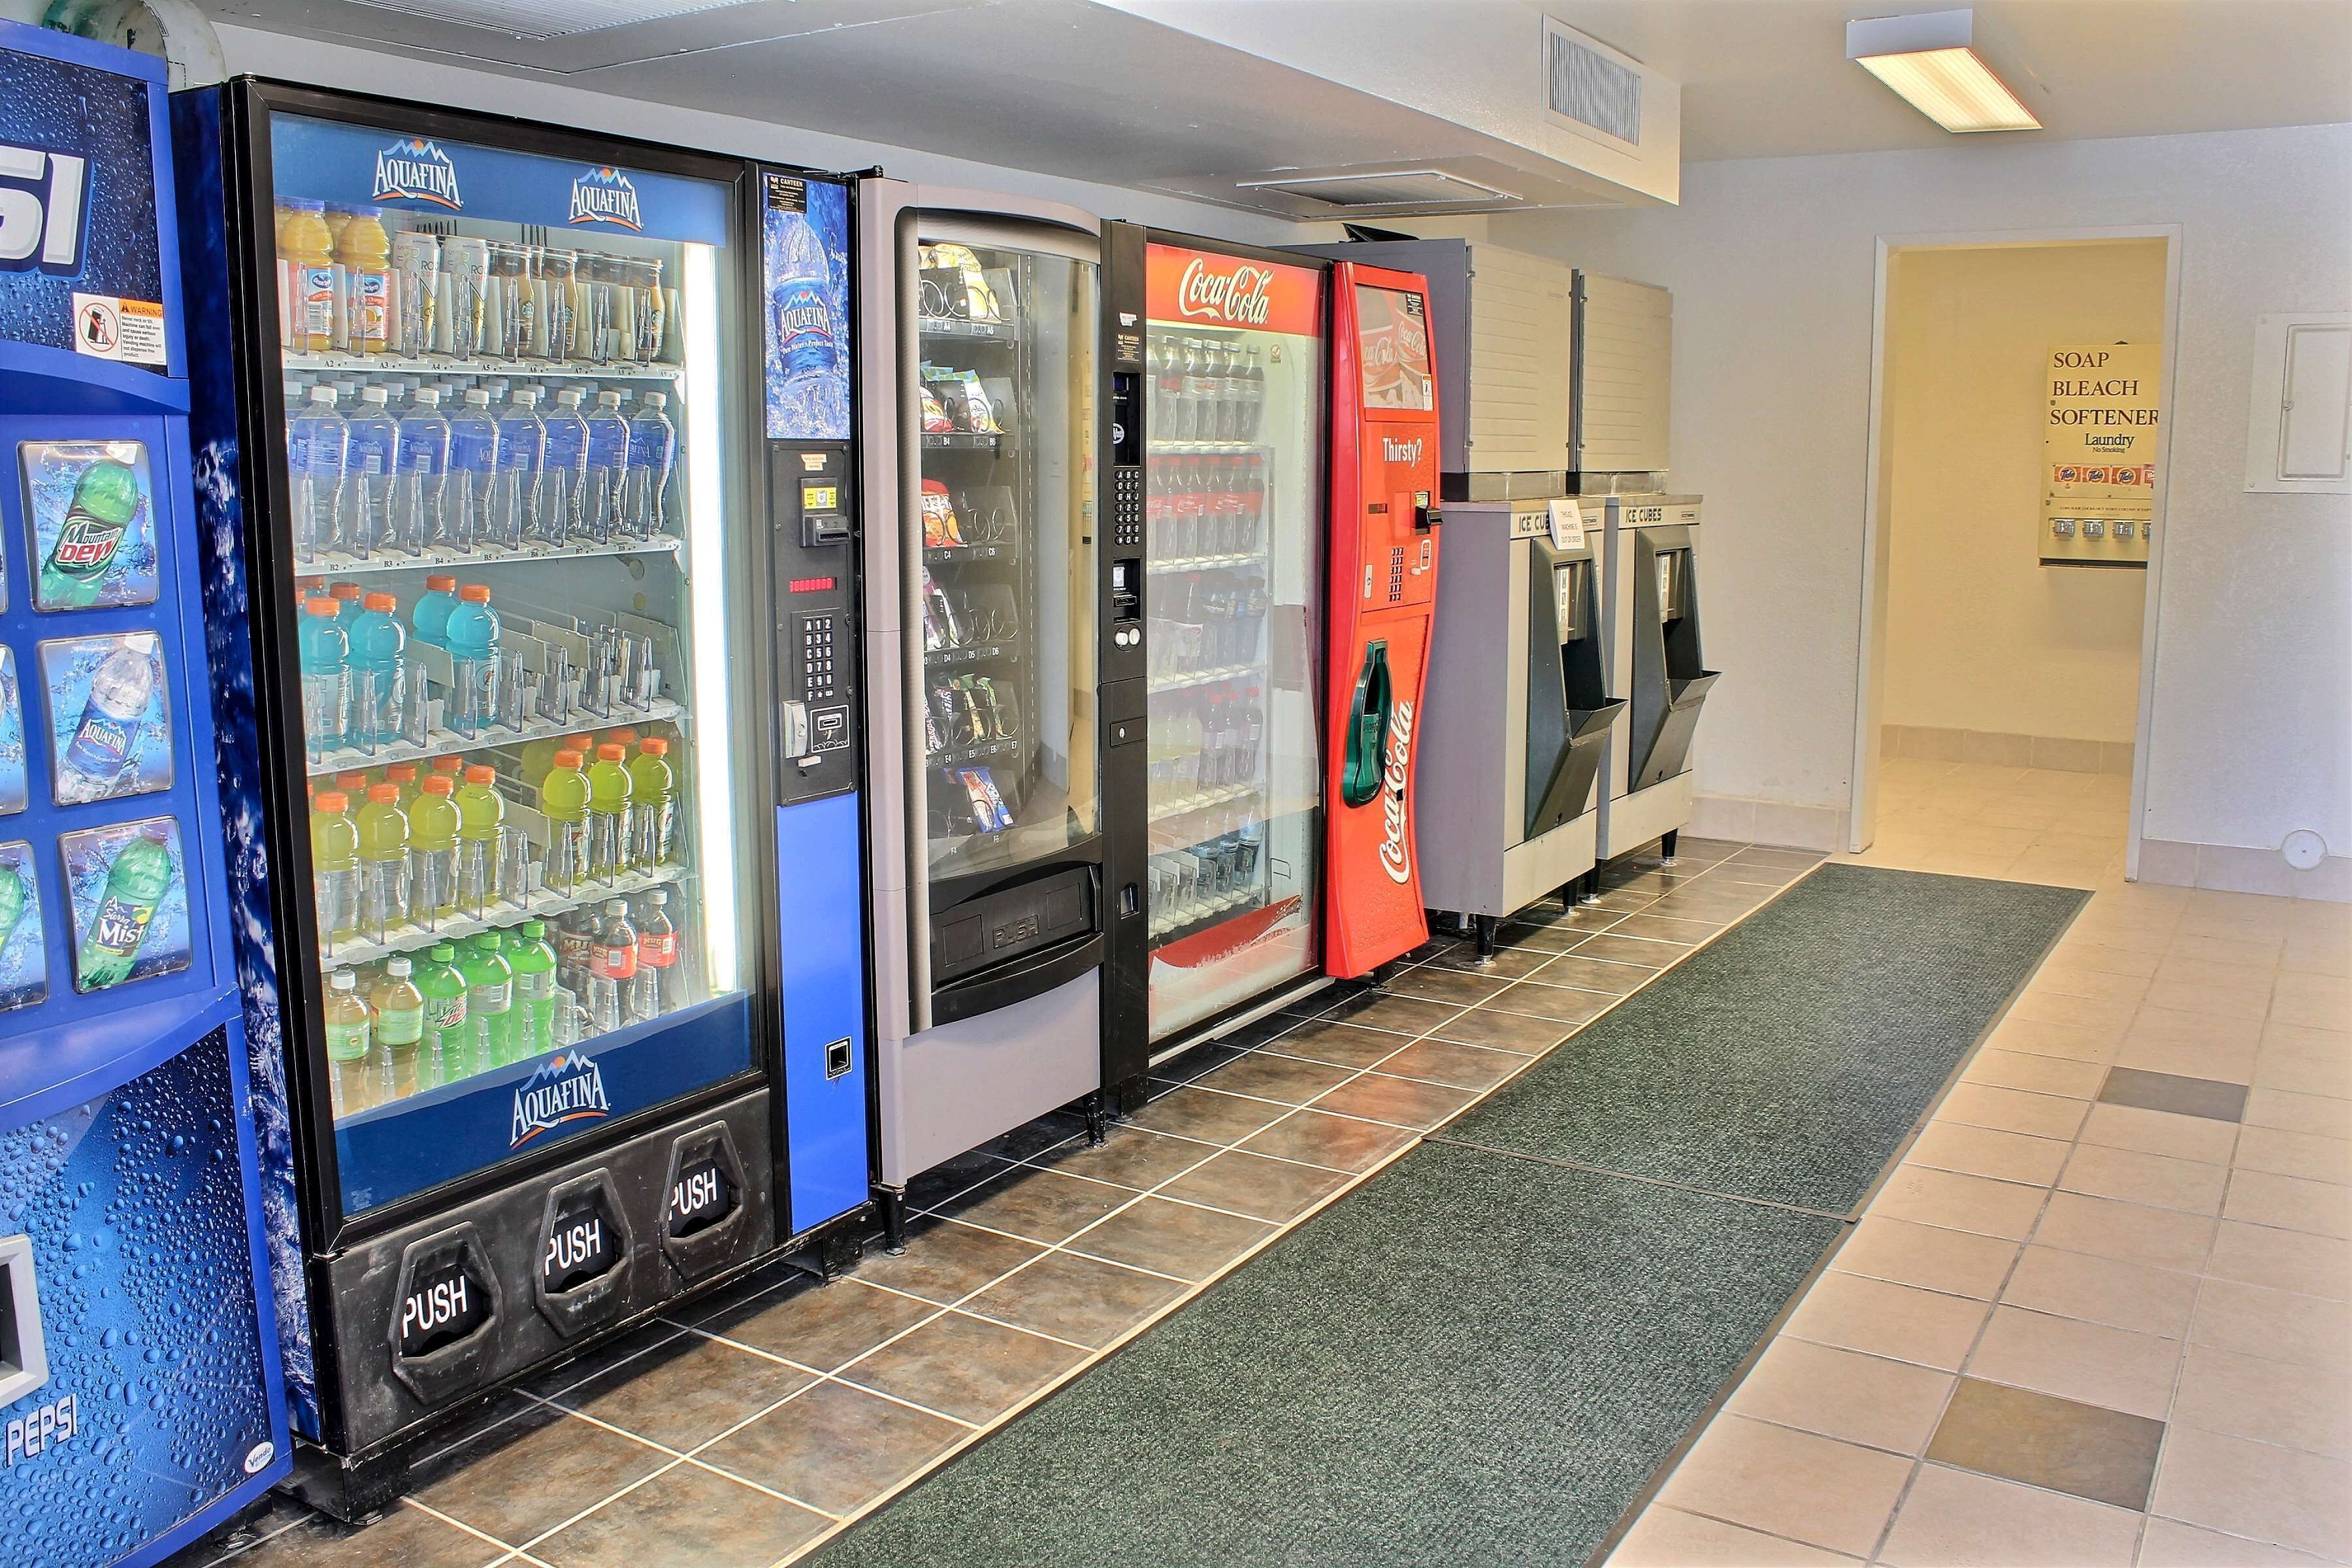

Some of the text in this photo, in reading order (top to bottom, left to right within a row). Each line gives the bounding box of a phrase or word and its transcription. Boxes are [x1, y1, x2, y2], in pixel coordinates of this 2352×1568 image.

[373, 150, 463, 208] AQUAFINA
[780, 178, 803, 188] CANTEEN
[569, 178, 644, 229] AQUAFINA
[131, 306, 162, 317] WARNING
[781, 304, 832, 343] AQUAFINA
[2053, 352, 2110, 368] SOAP
[2053, 380, 2139, 396] BLEACH
[2050, 410, 2159, 425] SOFTENER
[2085, 433, 2135, 449] Laundry
[1382, 437, 1423, 467] Thirsty?
[2060, 469, 2076, 480] Tide
[2089, 470, 2104, 481] Tide
[2118, 471, 2134, 482] Tide
[1519, 514, 1550, 532] ICE CUB
[1625, 508, 1661, 523] ICE CUBES
[66, 521, 121, 545] Mountain
[806, 619, 830, 631] A 1 2
[806, 632, 830, 645] B 3 4
[807, 647, 831, 659] C 5 6
[807, 661, 831, 673] D 7 8
[808, 674, 832, 687] E 9 0
[808, 691, 813, 701] F
[79, 718, 127, 756] AQUAFINA
[103, 908, 131, 924] Sierra
[97, 917, 146, 945] Mist
[564, 939, 587, 950] MU
[644, 938, 661, 946] MUG
[510, 1062, 611, 1146] AQUAFINA
[668, 1168, 717, 1221] PUSH
[544, 1218, 601, 1276] PUSH
[402, 1275, 466, 1339] PUSH
[7, 1394, 77, 1468] PEPSI
[248, 1447, 270, 1467] Vendo
